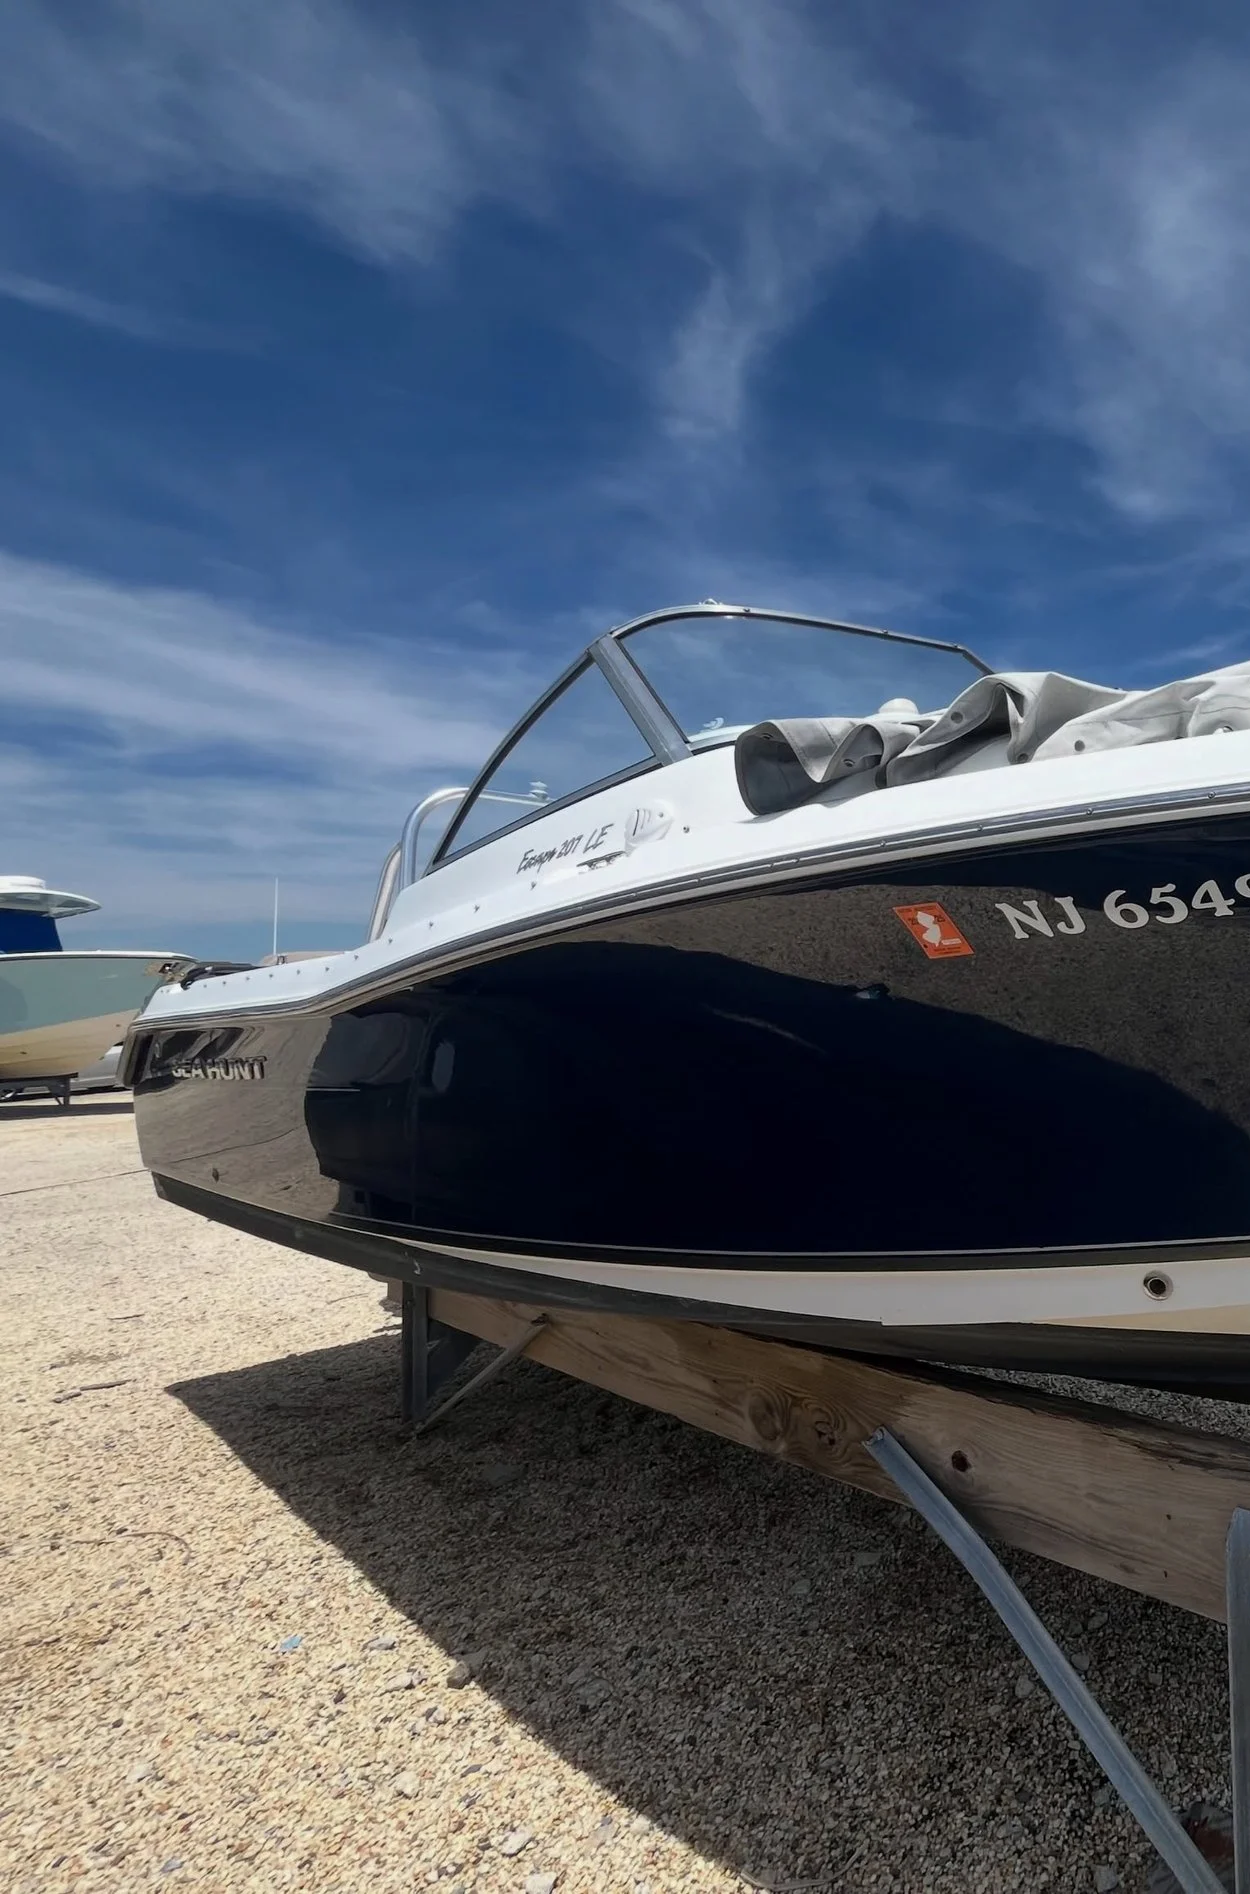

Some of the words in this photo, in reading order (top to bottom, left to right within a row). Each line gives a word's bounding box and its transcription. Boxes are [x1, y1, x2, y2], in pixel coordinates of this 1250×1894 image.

[556, 834, 584, 859] 207
[583, 823, 614, 853] LE
[995, 896, 1087, 939] NJ
[172, 1058, 205, 1078] SEA
[207, 1056, 267, 1079] HUNT
